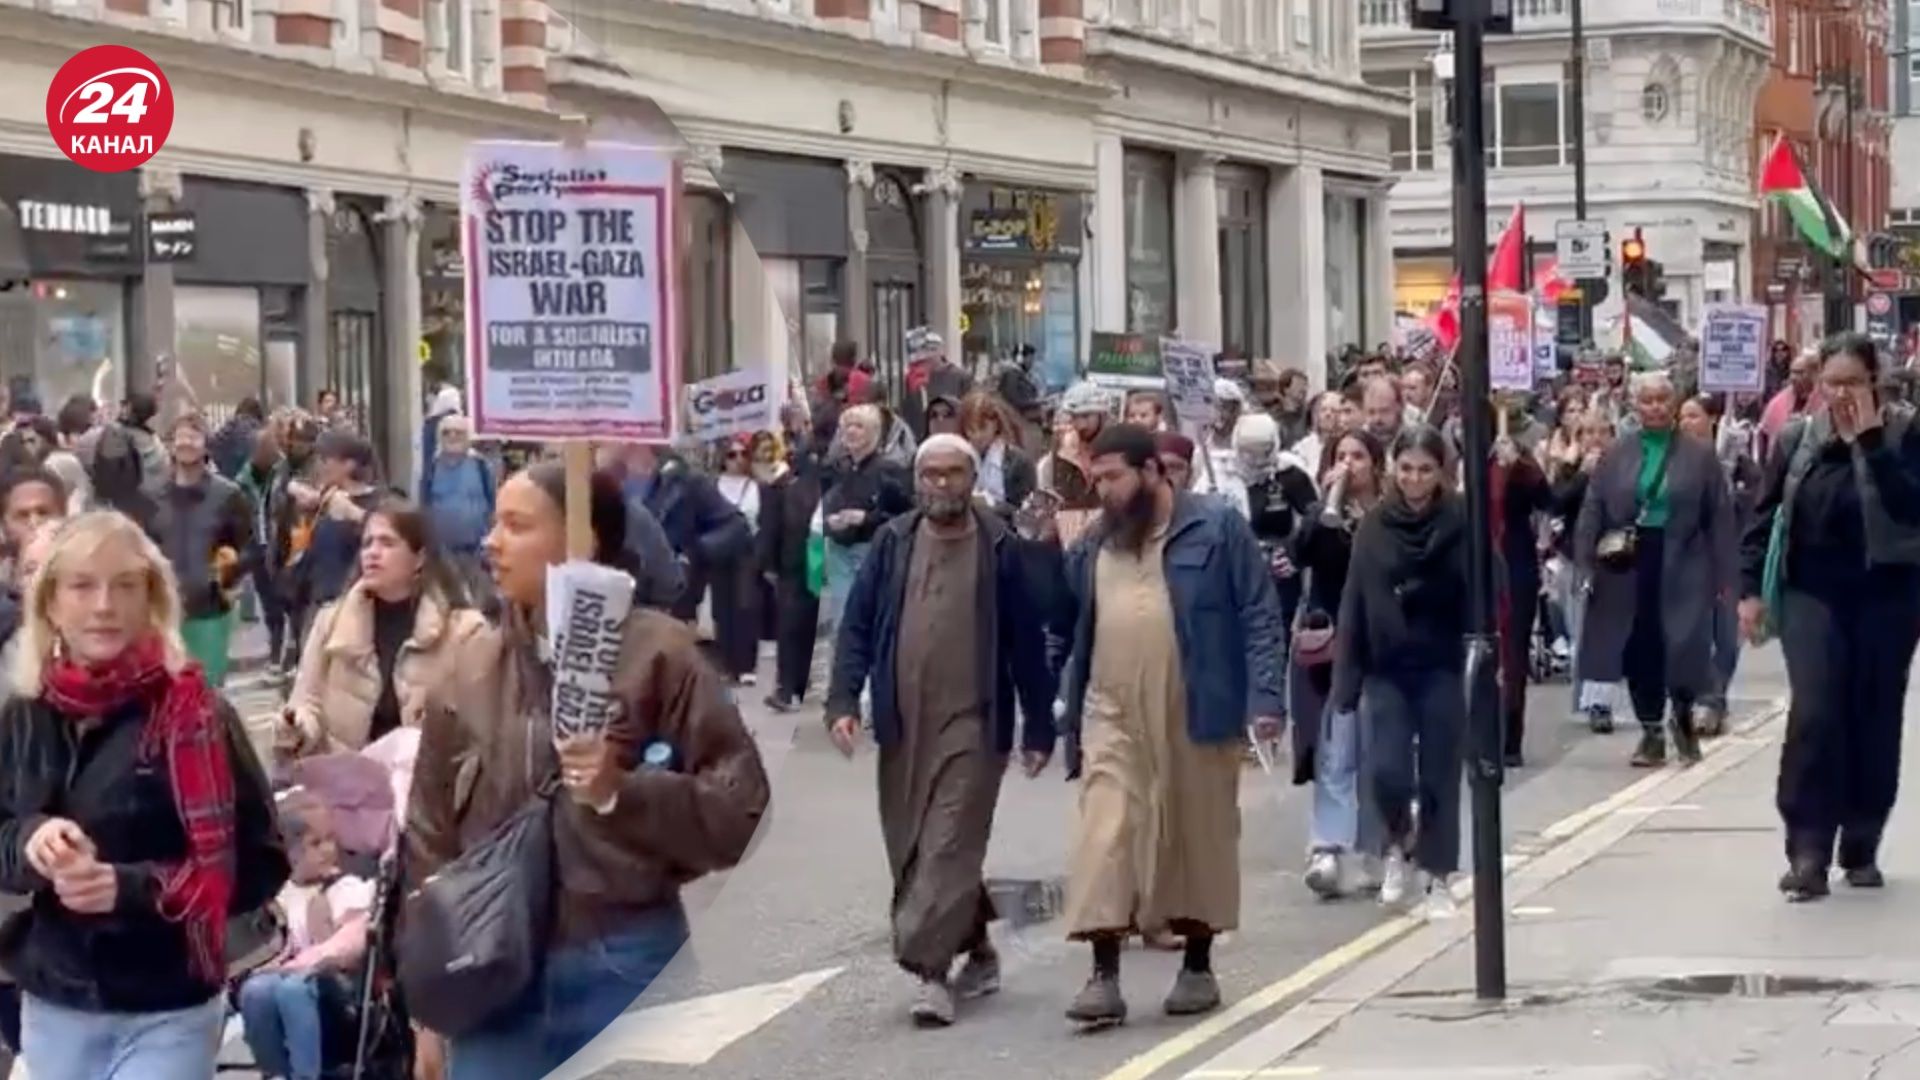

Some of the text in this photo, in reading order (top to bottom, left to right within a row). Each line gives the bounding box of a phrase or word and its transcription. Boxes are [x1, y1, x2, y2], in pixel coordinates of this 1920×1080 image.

[485, 208, 634, 244] STOP THE
[487, 249, 645, 278] ISRAEL-GAZA
[529, 280, 606, 315] WAR
[489, 326, 526, 346] FOR
